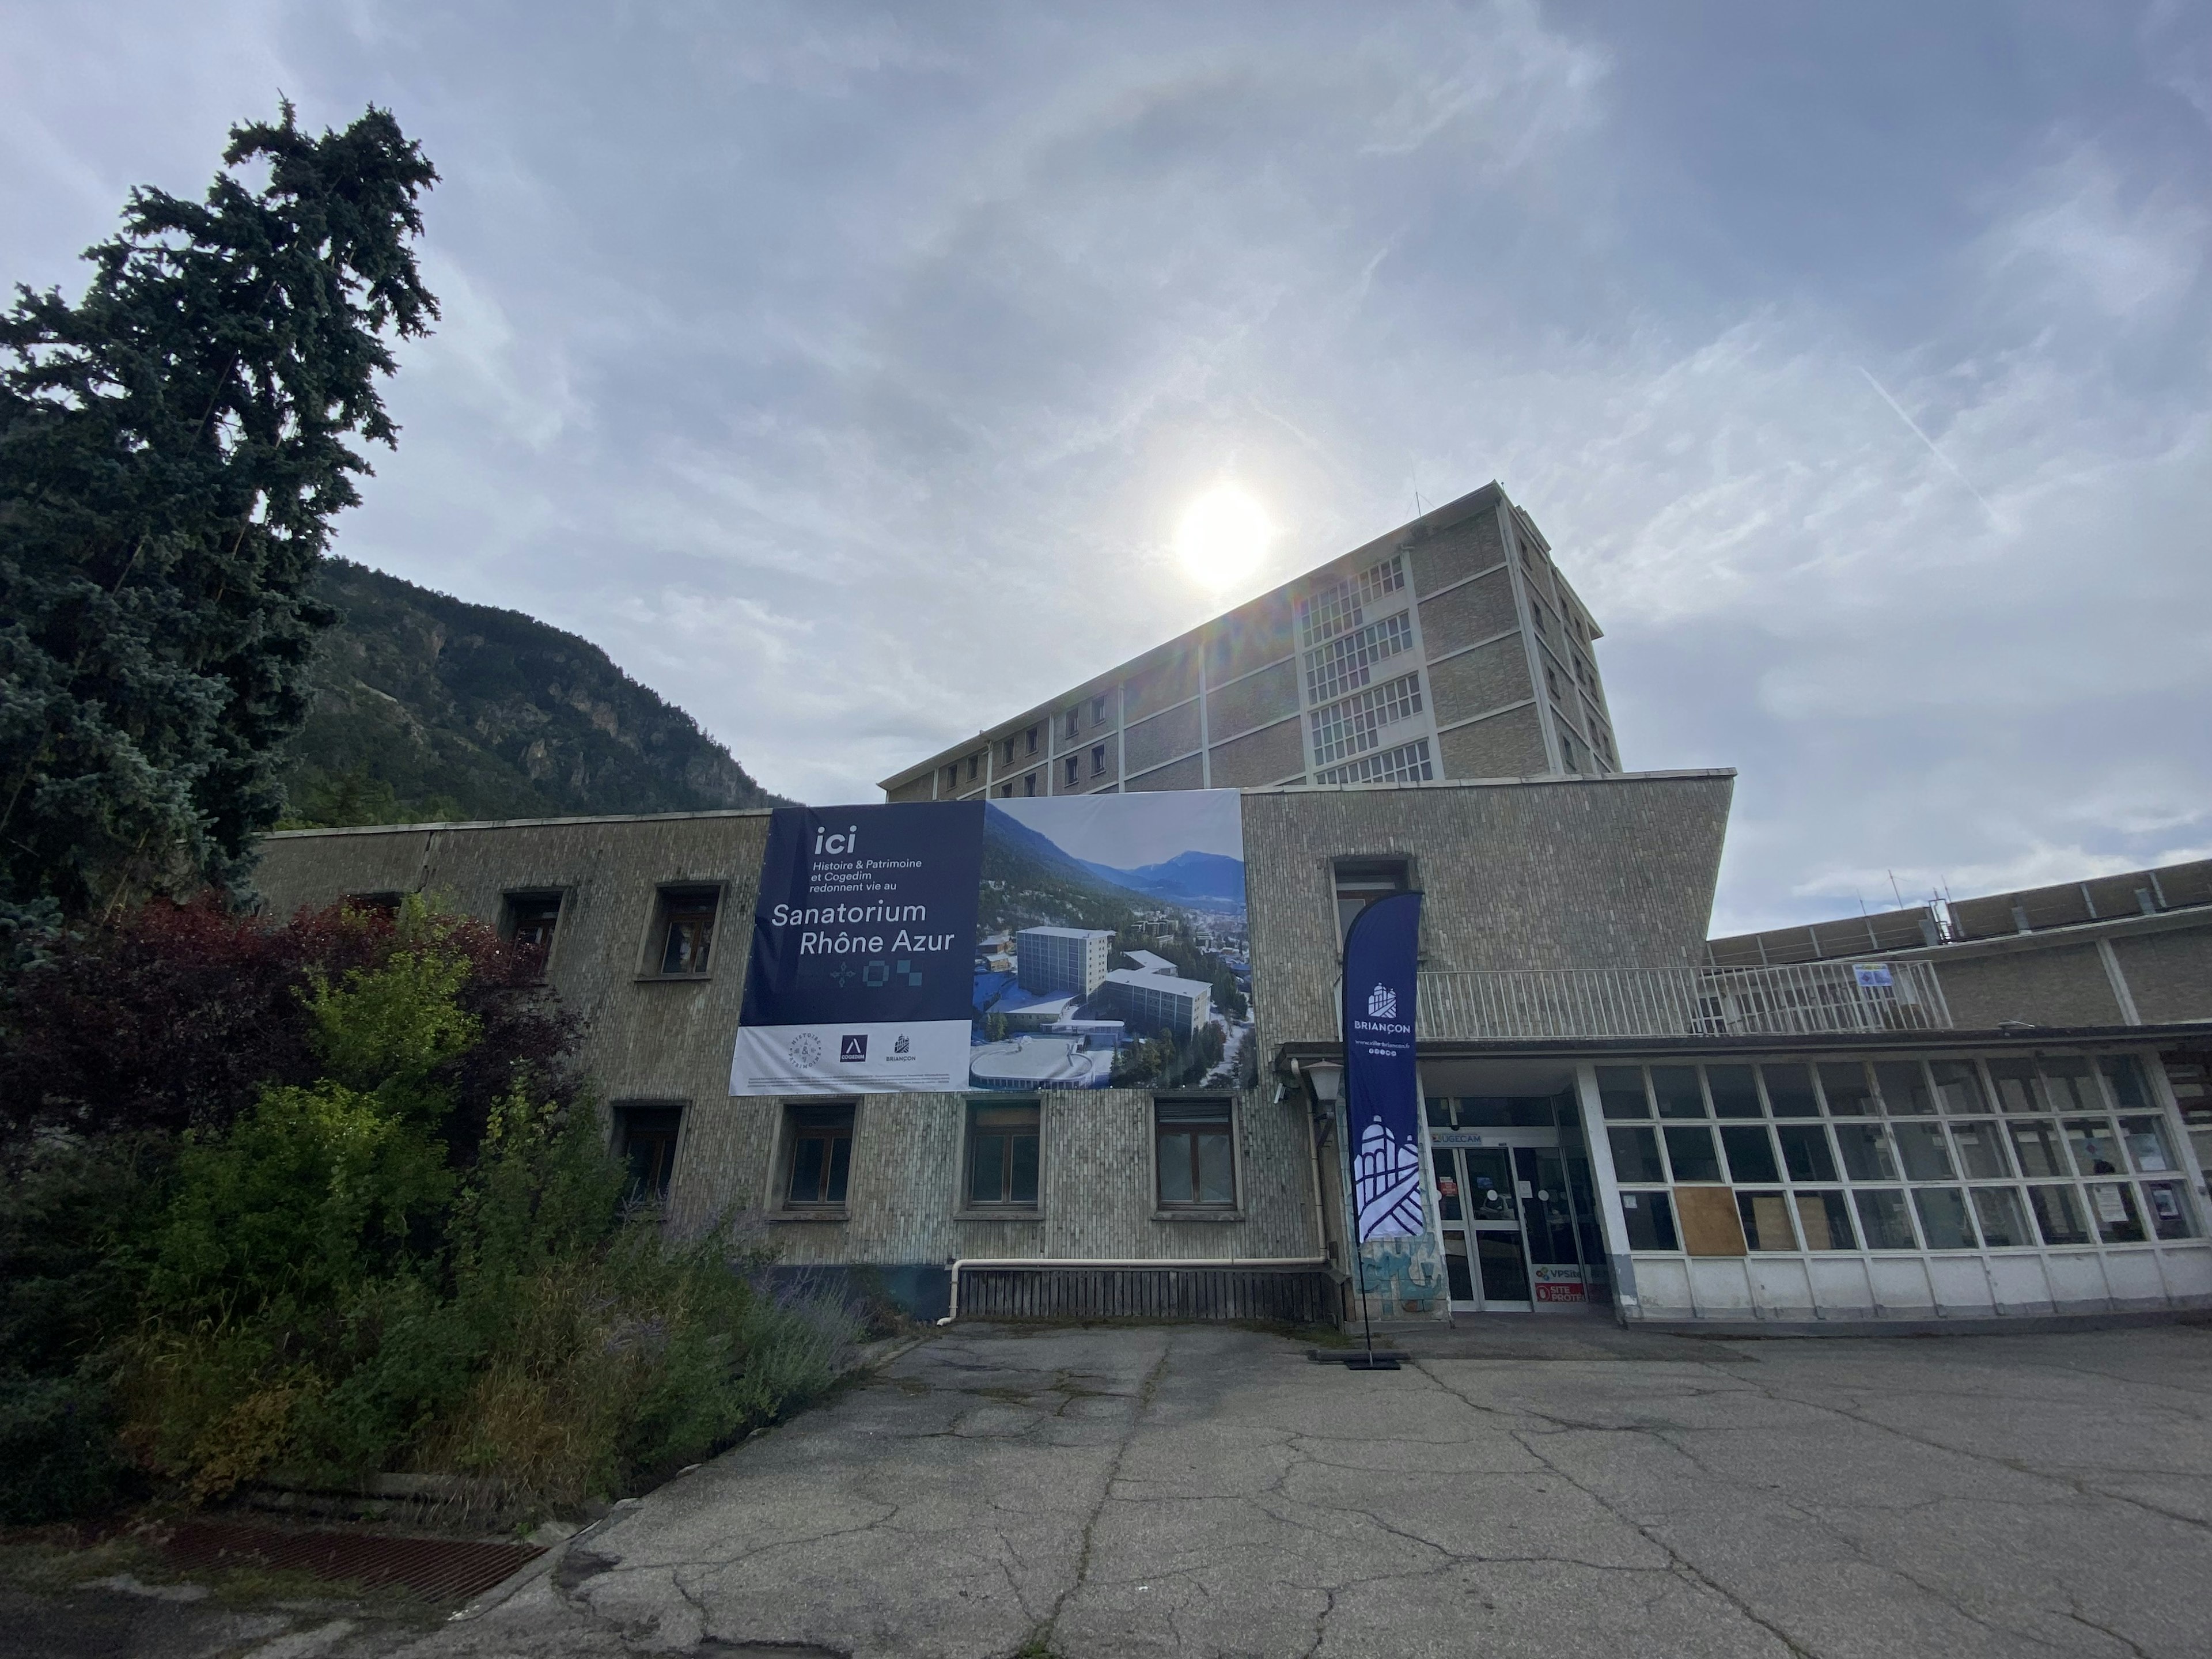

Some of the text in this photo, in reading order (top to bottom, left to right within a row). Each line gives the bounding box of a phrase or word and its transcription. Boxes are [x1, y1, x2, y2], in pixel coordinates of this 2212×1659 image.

[815, 825, 857, 855] ici
[813, 858, 922, 871] Histoire & Patrimoine
[811, 872, 872, 882] et Cogedim
[810, 884, 863, 893] redonnent
[772, 899, 926, 926] Sanatorium
[800, 929, 955, 955] Rhône Azur
[1354, 1021, 1411, 1034] BRIANÇON
[1551, 1286, 1571, 1294] SITE
